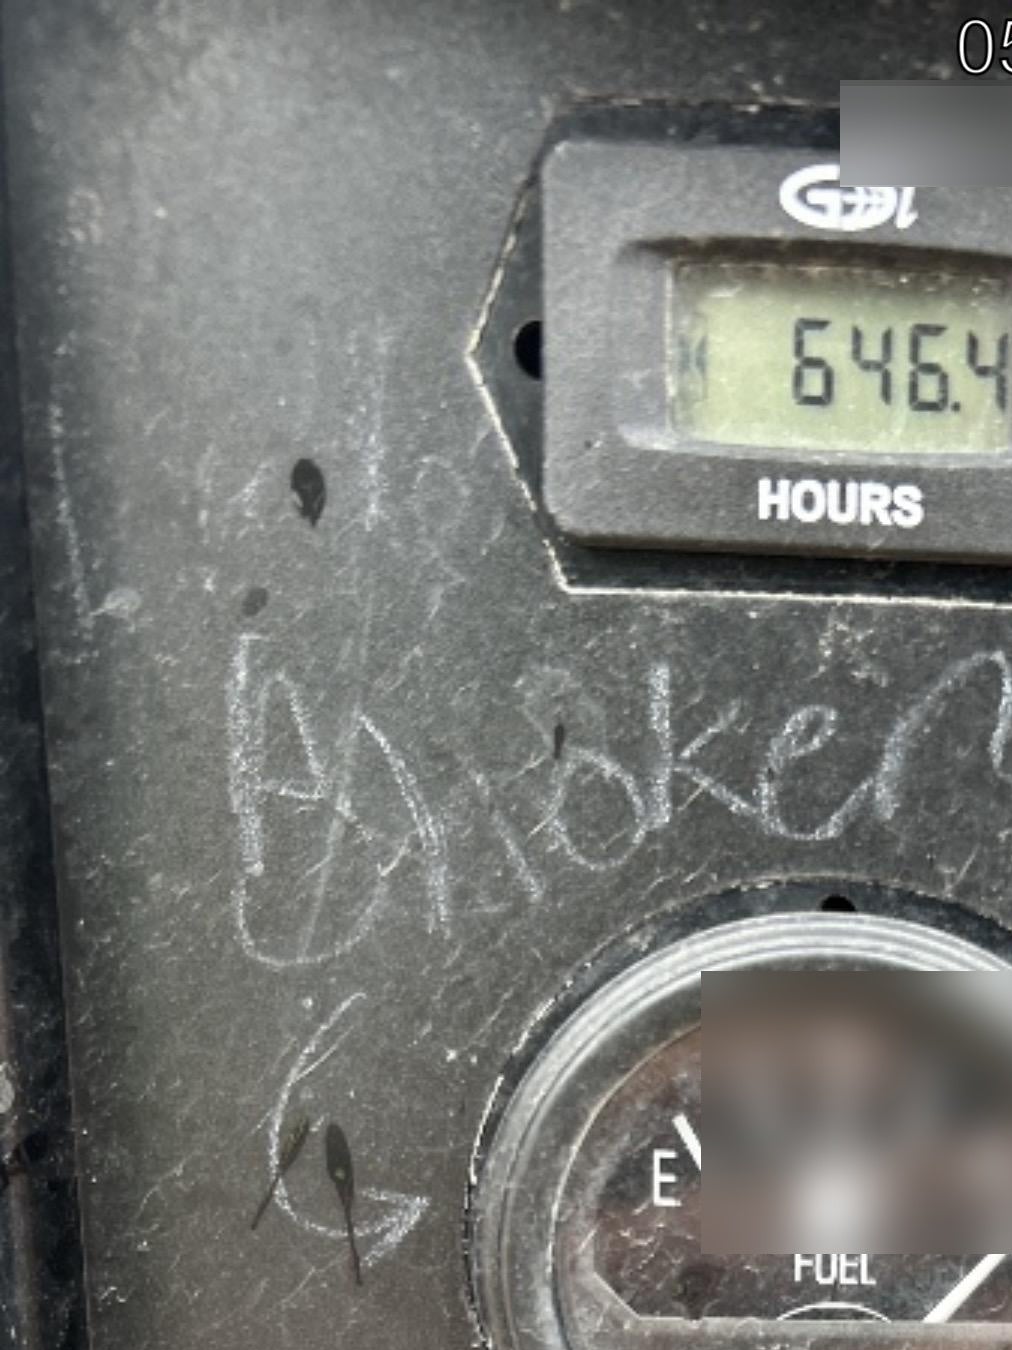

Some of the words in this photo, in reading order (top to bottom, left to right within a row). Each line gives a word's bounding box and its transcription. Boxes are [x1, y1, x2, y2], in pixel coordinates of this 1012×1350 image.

[794, 319, 1009, 413] 646.4
[757, 477, 925, 530] HOURS
[652, 1149, 683, 1208] E
[793, 1252, 877, 1286] FUEL
